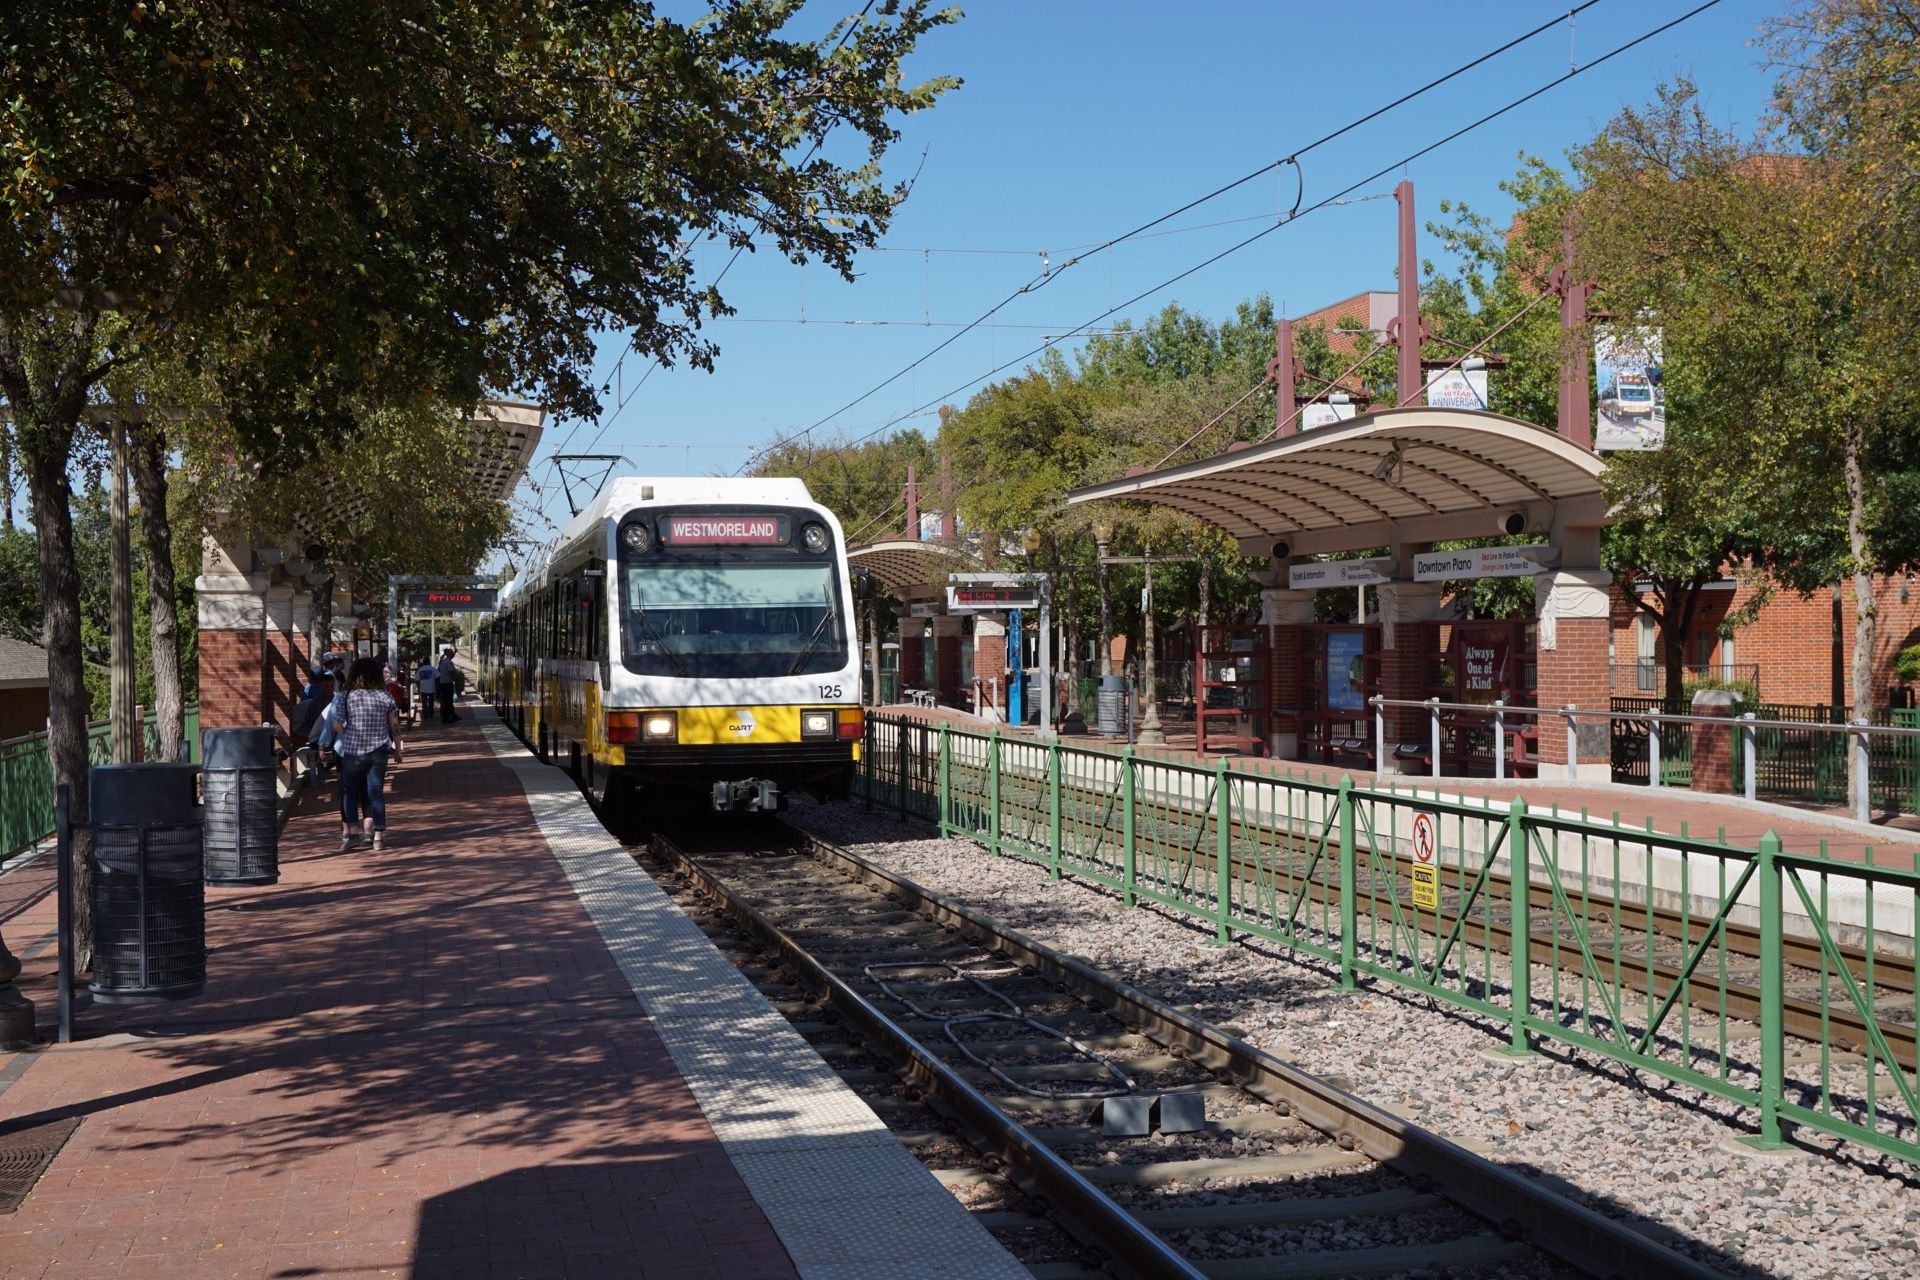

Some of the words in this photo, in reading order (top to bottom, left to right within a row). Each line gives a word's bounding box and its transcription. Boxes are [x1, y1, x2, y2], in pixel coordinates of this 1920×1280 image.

[673, 523, 774, 537] WESTMORELAND
[1503, 551, 1515, 559] Parker
[1418, 560, 1451, 574] Downtown
[1453, 558, 1472, 570] Plano
[1510, 562, 1522, 570] Parker
[1465, 646, 1495, 661] Always
[1467, 661, 1482, 674] One
[1483, 661, 1493, 674] of
[1466, 680, 1471, 689] a
[1472, 676, 1492, 690] Kind
[818, 685, 842, 698] 125
[1415, 872, 1433, 882] CAUTION
